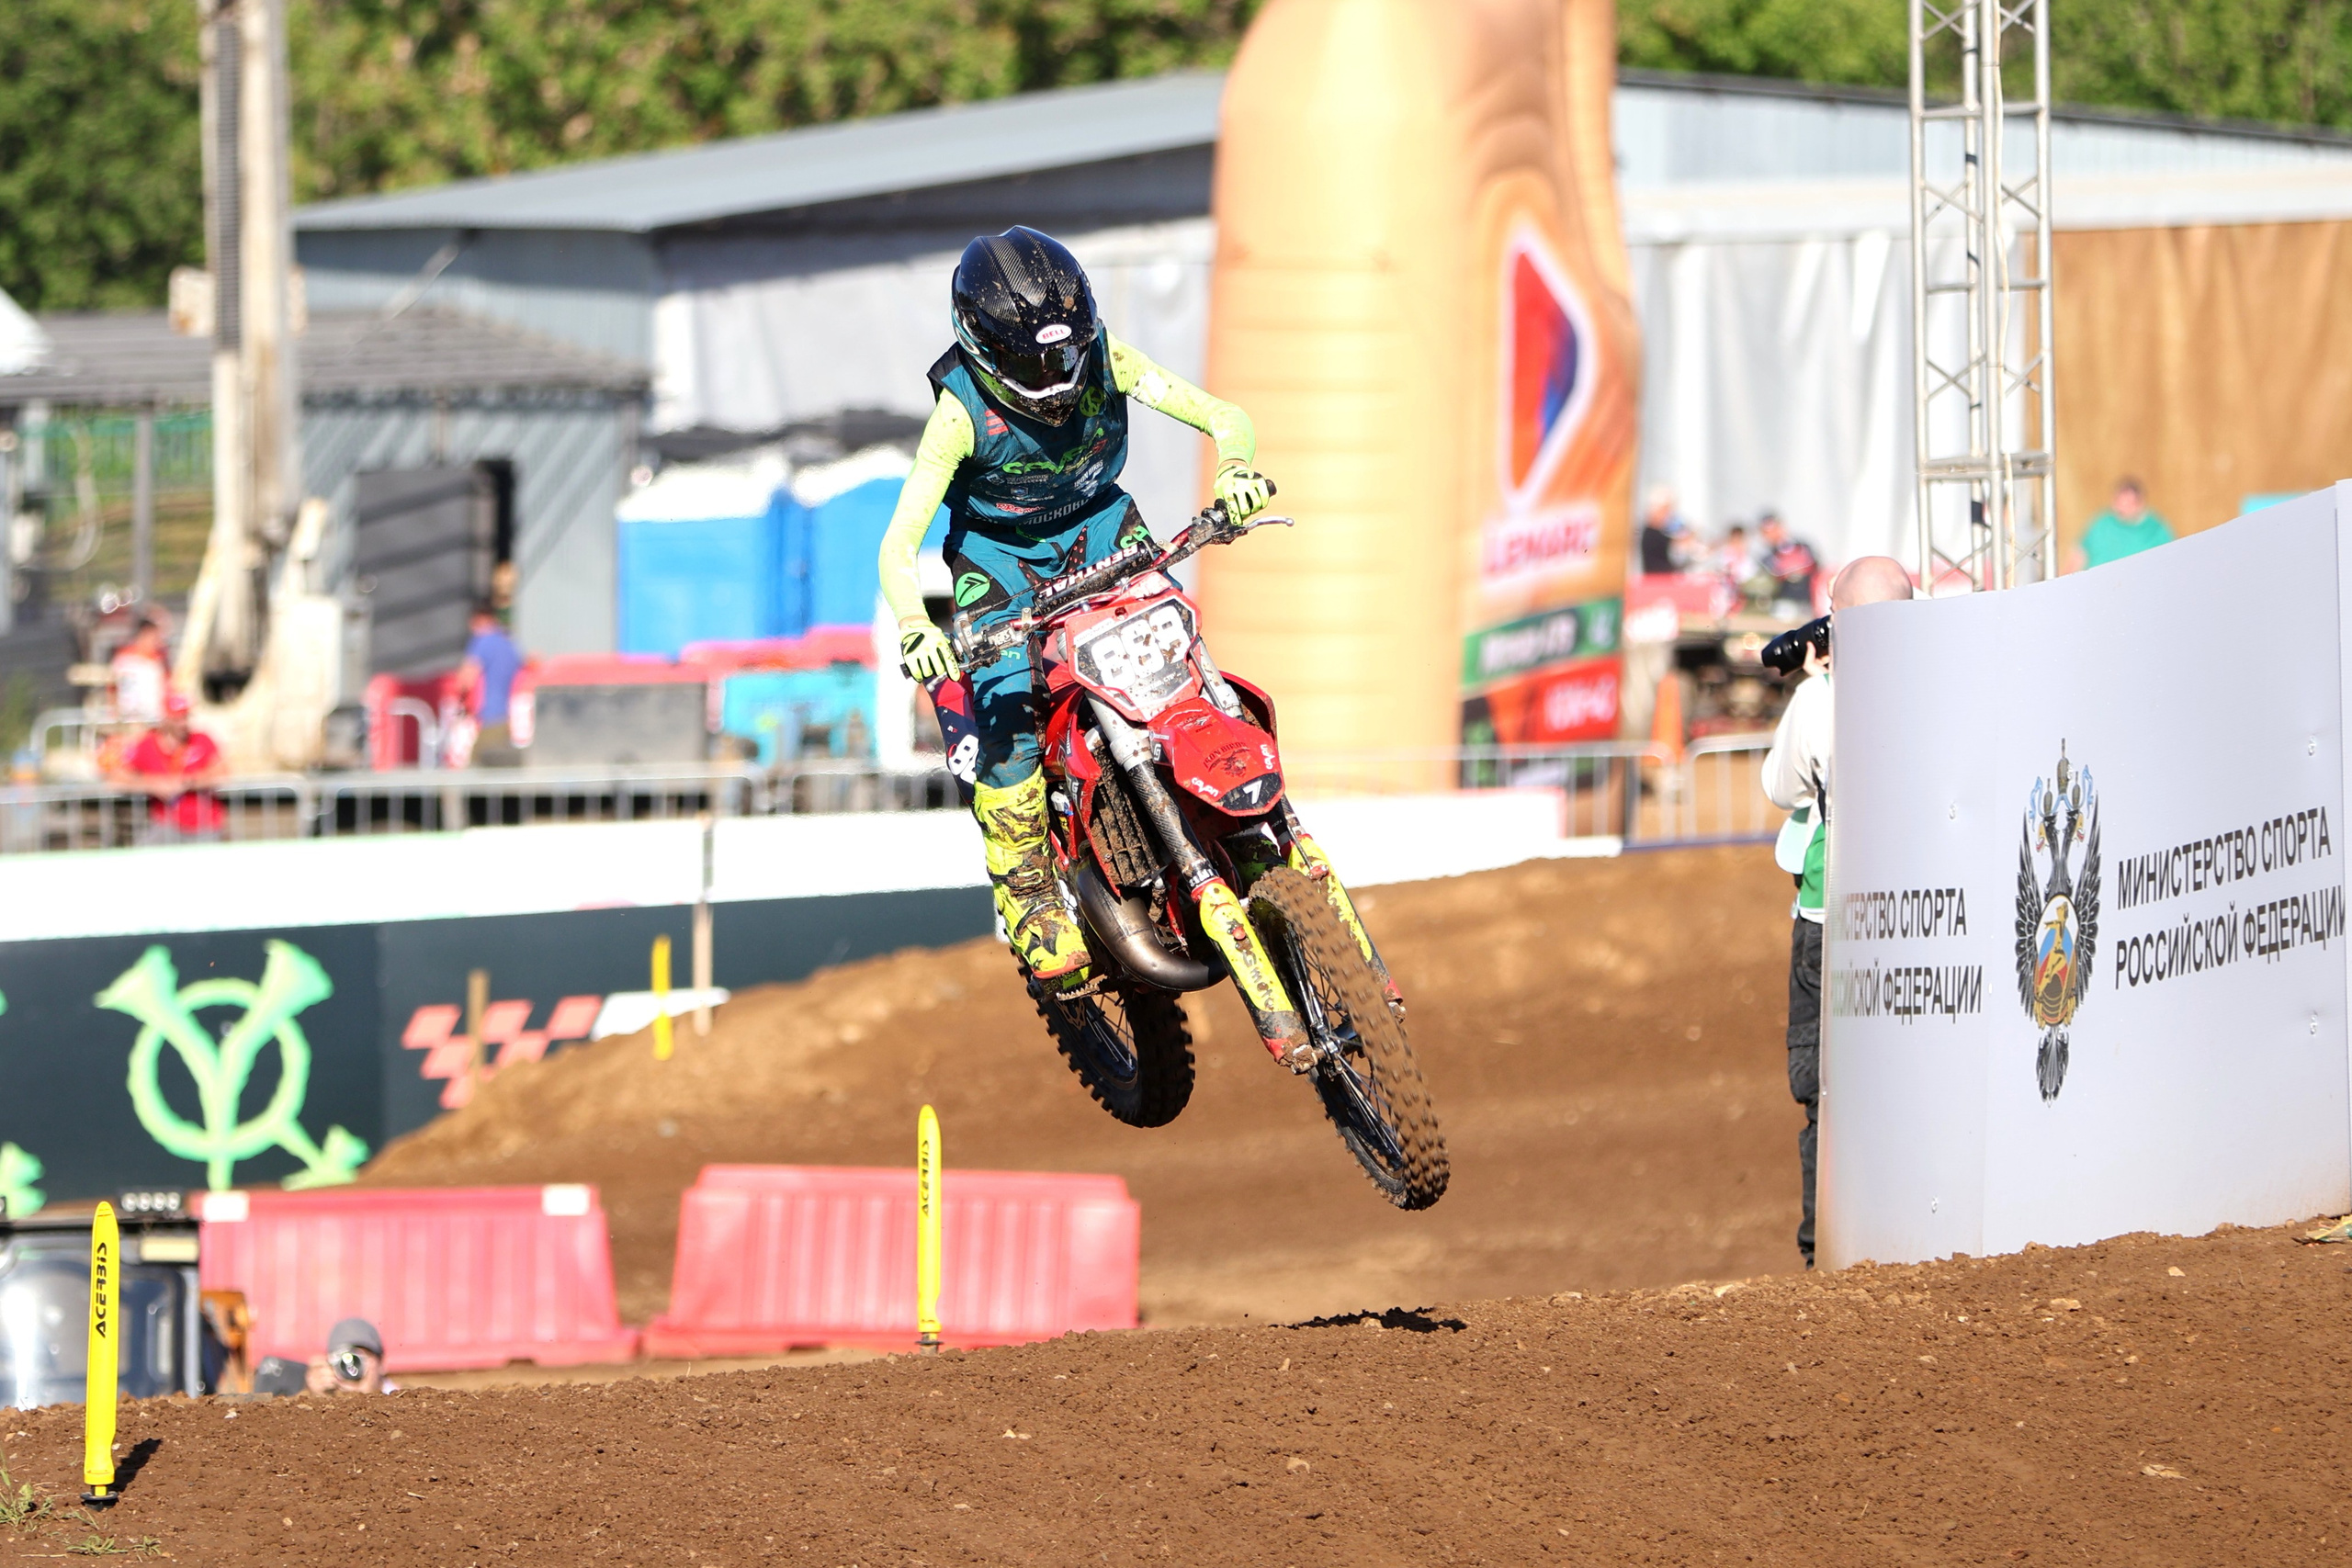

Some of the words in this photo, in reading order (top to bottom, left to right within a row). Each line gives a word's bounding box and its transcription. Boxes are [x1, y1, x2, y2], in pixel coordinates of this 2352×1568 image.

[1042, 329, 1066, 340] BELL
[1039, 544, 1138, 597] RENTHAL
[1203, 748, 1222, 769] IRON
[2117, 825, 2257, 910] МИНИСТЕРСТВО
[2261, 806, 2332, 873] СПОРТА
[1900, 887, 1967, 939] СПОРТА
[2115, 899, 2239, 990] РОССИЙСКОЙ
[2244, 885, 2346, 964] ФЕДЕРАЦИИ
[1884, 964, 1983, 1026] ФЕДЕРАЦИИ
[921, 1140, 930, 1219] ACERBIS
[96, 1242, 107, 1339] ACERBIS
